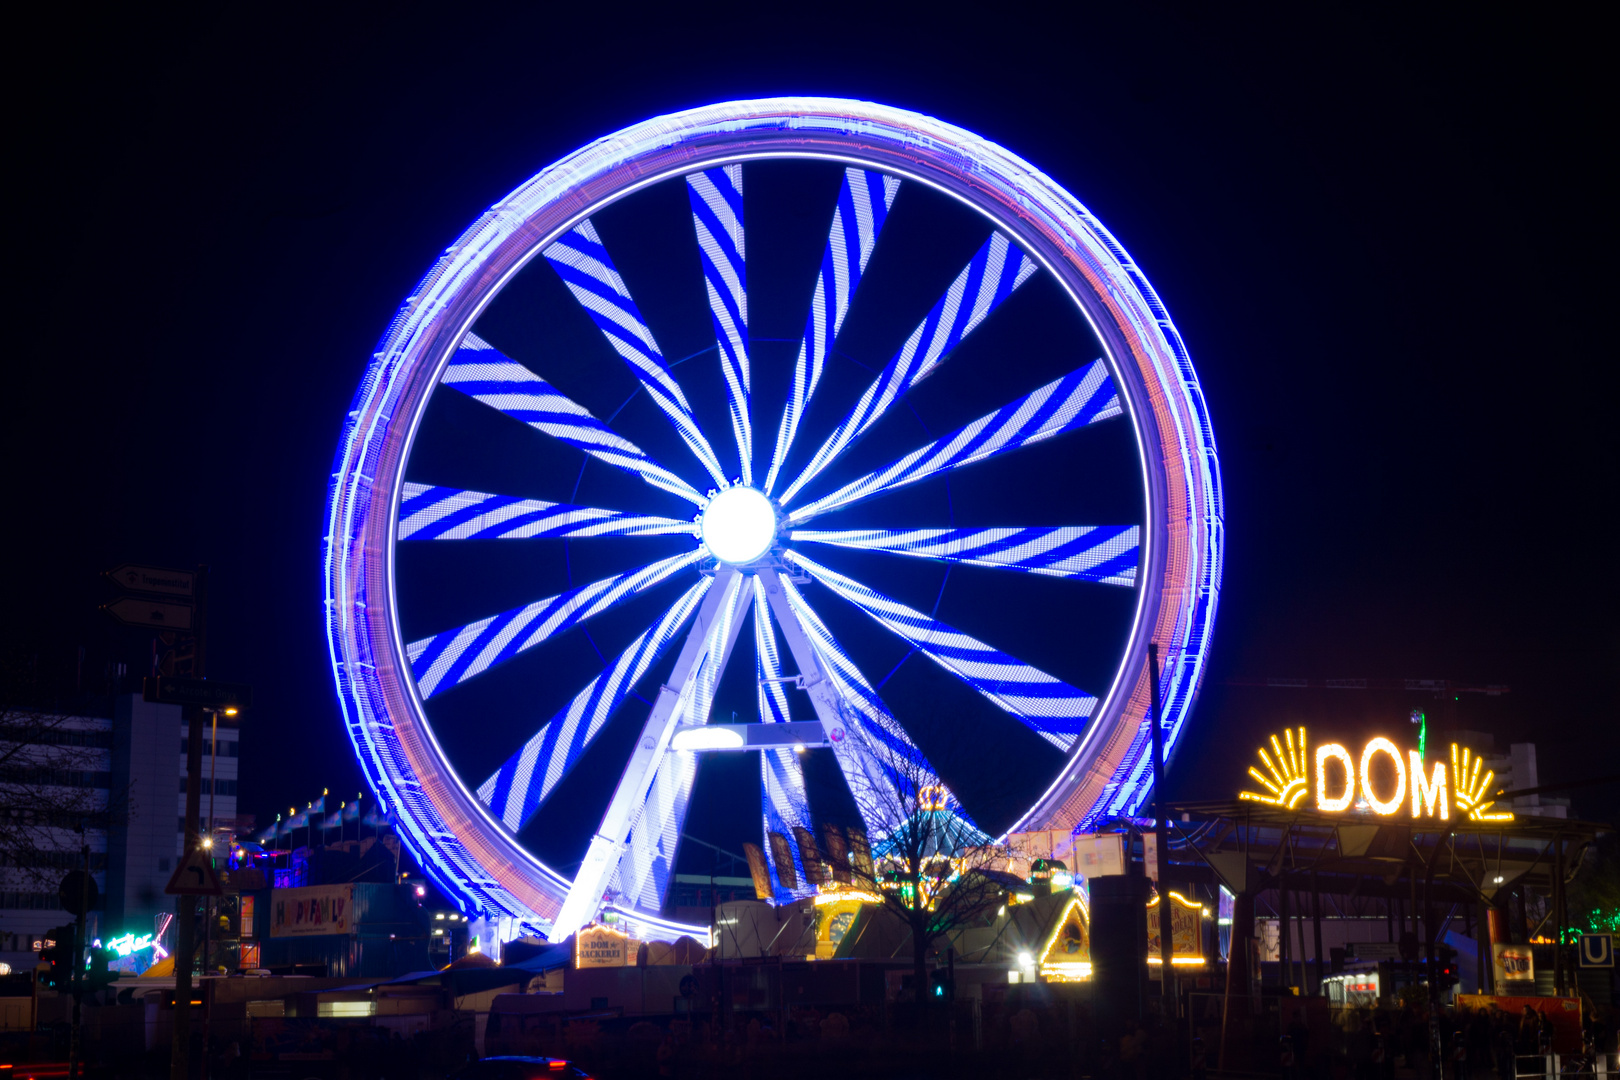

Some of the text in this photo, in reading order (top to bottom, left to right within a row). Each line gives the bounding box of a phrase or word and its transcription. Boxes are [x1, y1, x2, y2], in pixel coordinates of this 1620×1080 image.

[179, 685, 237, 700] Arcotel Onyx
[1316, 737, 1449, 820] DOM
[591, 941, 608, 949] DOM
[1584, 937, 1607, 963] U
